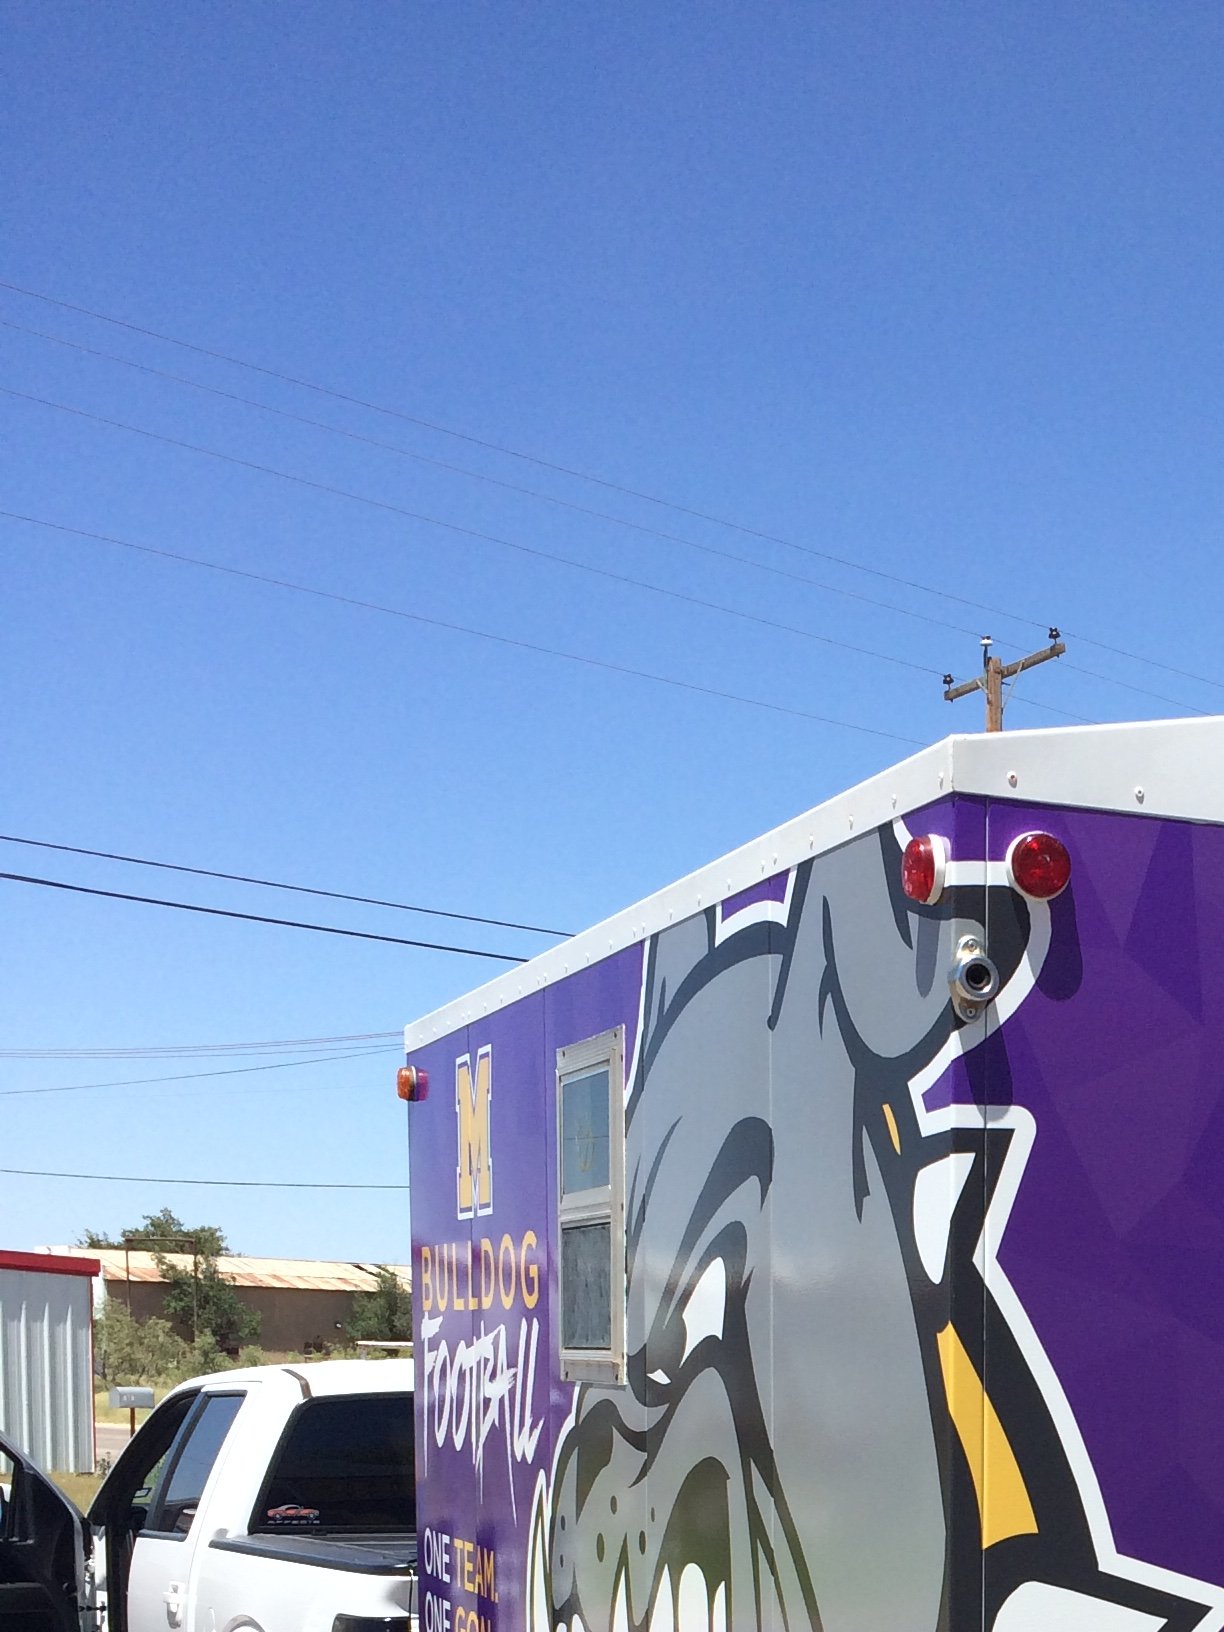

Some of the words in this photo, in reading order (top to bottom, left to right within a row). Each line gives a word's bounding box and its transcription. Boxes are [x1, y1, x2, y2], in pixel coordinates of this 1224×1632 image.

[456, 1044, 493, 1220] M
[421, 1229, 539, 1312] BULLDOG
[422, 1312, 545, 1528] FOOTBALL
[424, 1527, 451, 1584] ONE
[454, 1537, 499, 1603] TEAM.
